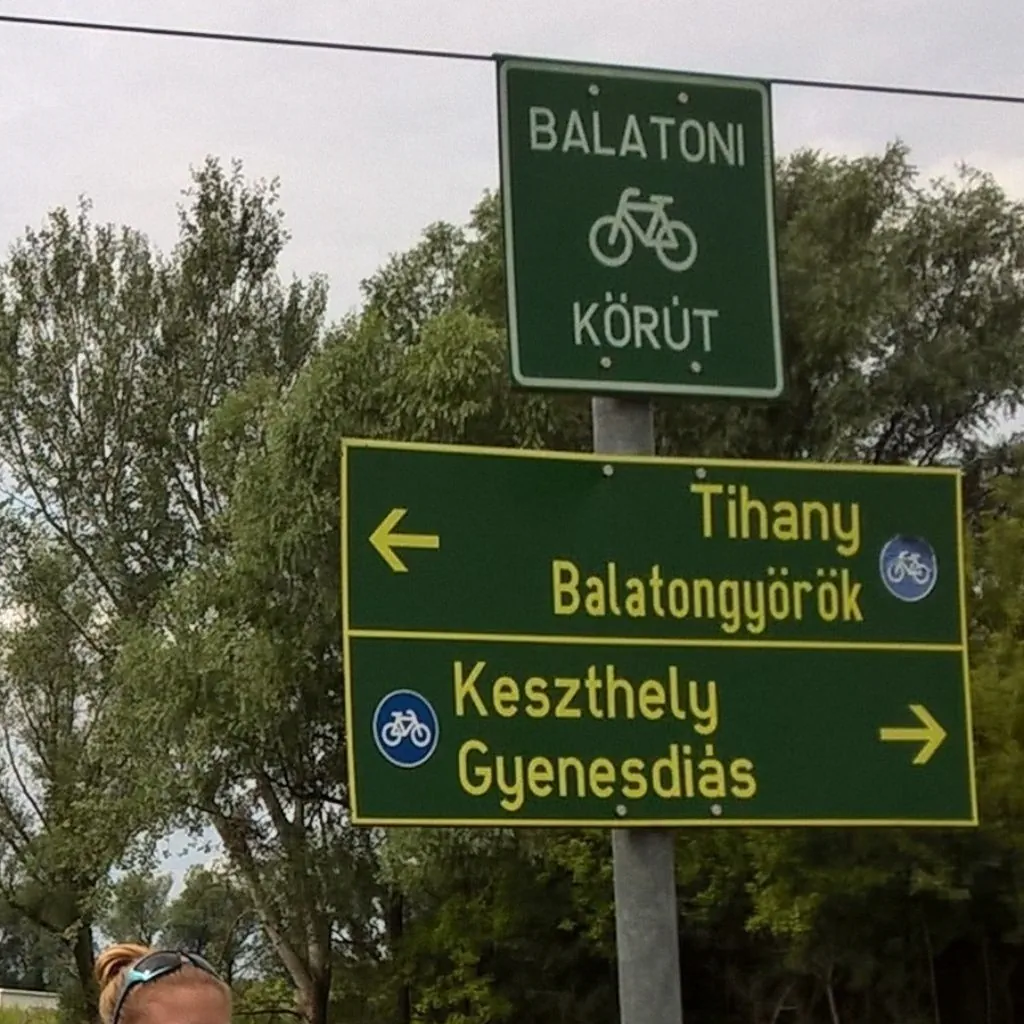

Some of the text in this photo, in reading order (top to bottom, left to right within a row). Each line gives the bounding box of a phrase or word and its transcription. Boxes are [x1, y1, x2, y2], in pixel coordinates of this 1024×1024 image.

[529, 106, 746, 167] BALATONI
[572, 292, 720, 353] KÖRÚT
[690, 483, 862, 557] Tihany
[552, 559, 864, 634] Balatongyörök
[451, 660, 719, 736] Keszthely
[457, 740, 757, 812] Gyenesdiás
